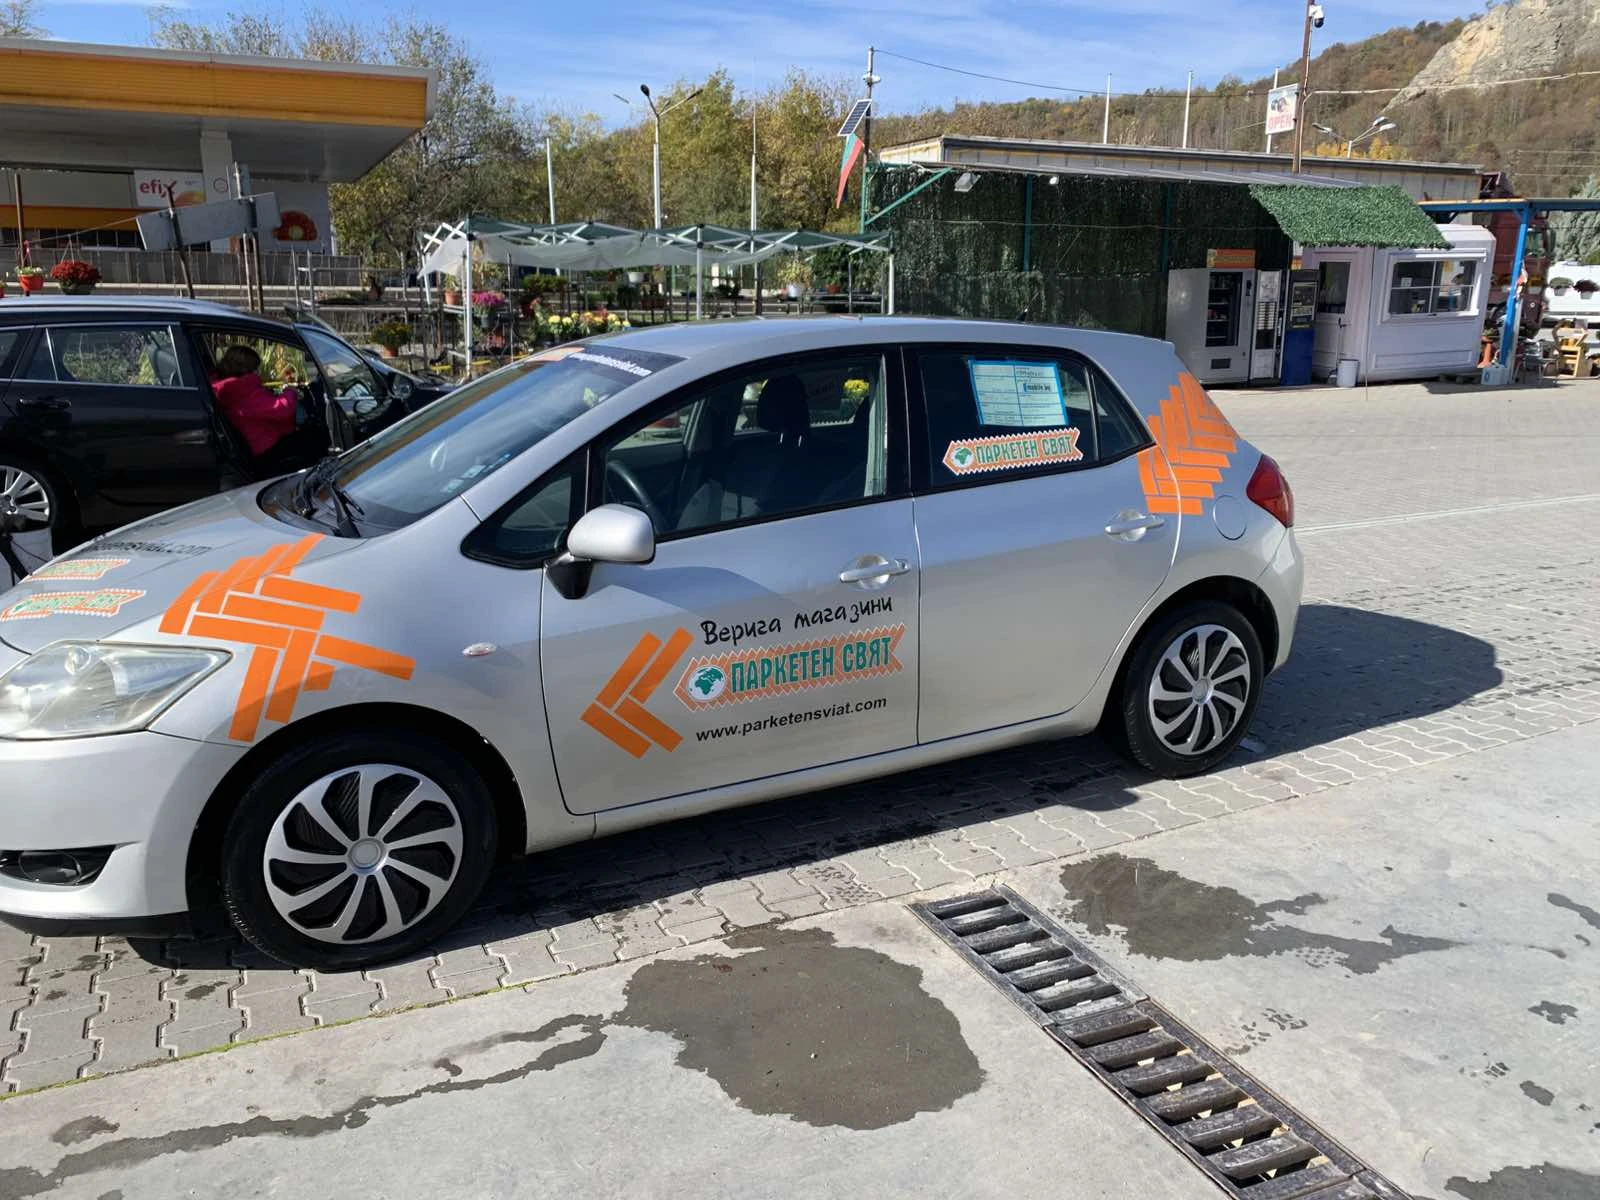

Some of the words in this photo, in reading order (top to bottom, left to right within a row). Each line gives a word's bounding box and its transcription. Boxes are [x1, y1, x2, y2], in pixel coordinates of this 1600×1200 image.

[975, 440, 1038, 465] ПАРКЕТЕН
[1041, 435, 1073, 455] СВЯТ
[700, 617, 781, 646] Верига
[794, 596, 893, 629] магазини
[731, 645, 835, 693] ПАРКЕТЕН
[842, 636, 892, 673] СВЯТ
[696, 696, 887, 742] www.parketensviat.com
